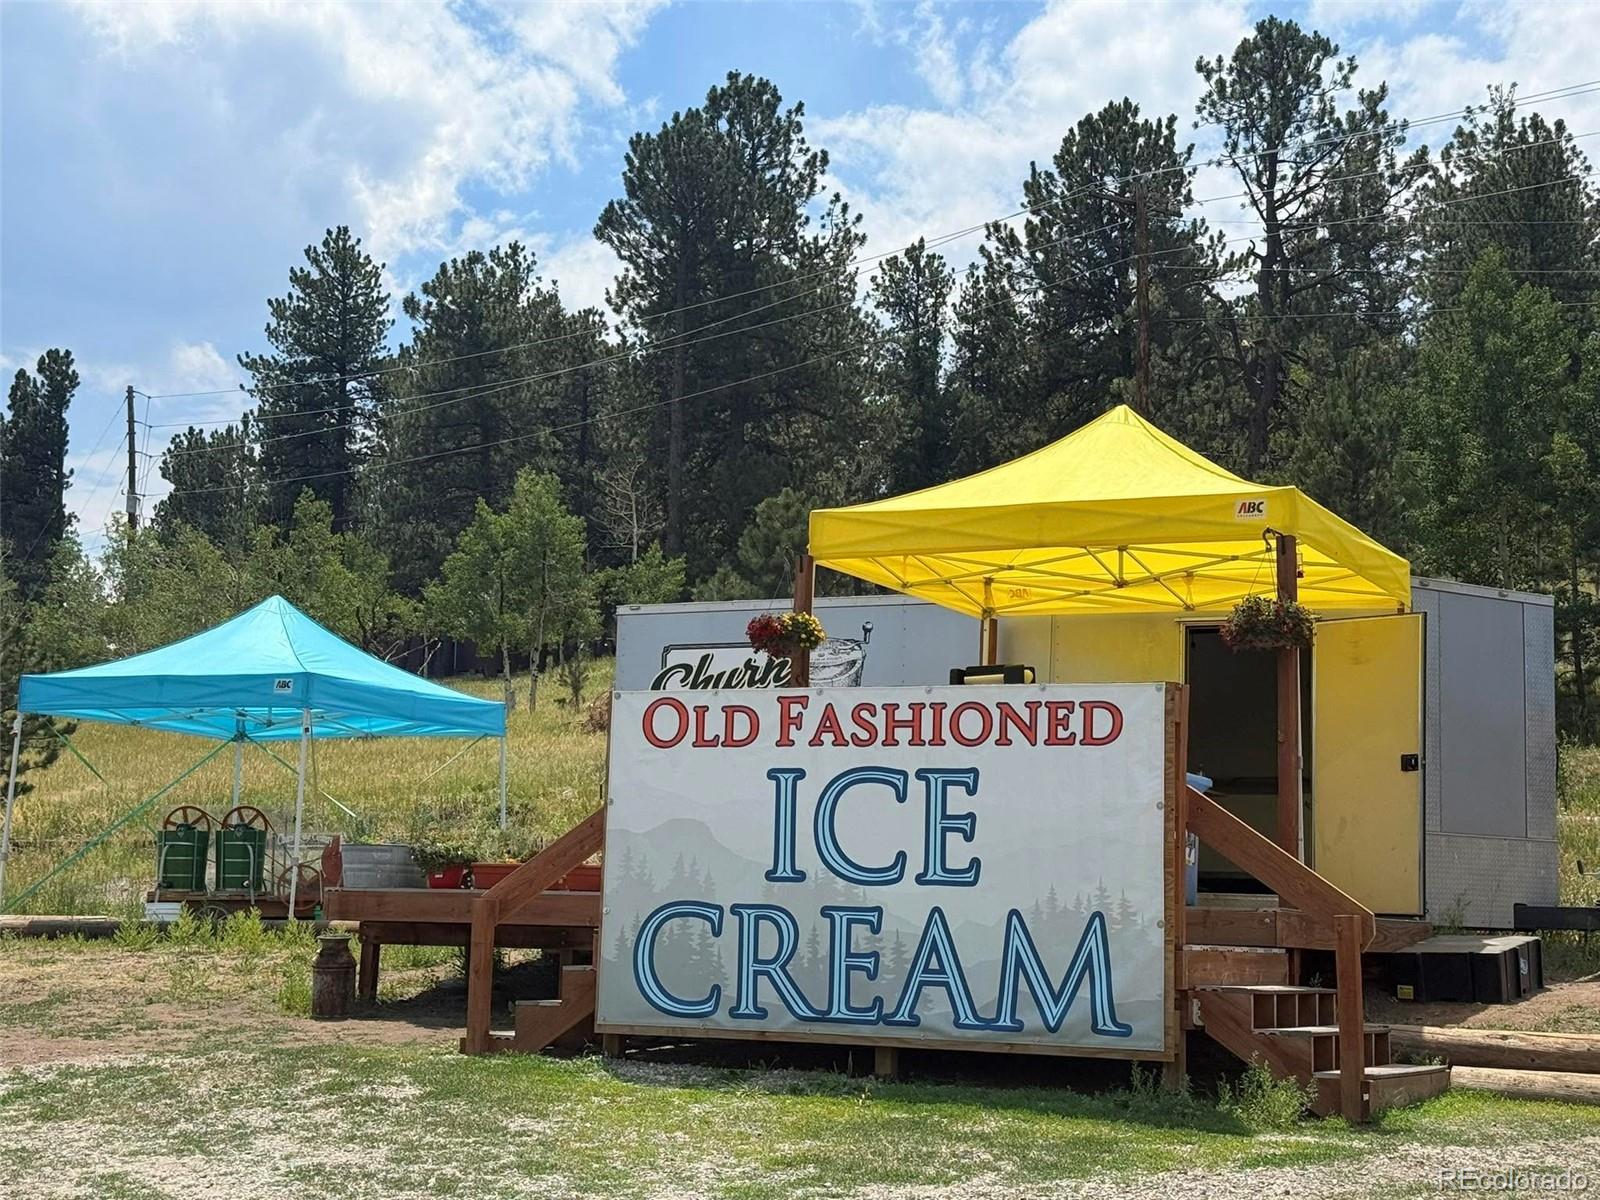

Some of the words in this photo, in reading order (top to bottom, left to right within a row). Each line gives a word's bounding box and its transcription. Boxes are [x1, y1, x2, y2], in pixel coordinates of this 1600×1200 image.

[1237, 501, 1264, 514] ABC
[275, 680, 292, 689] ABC
[650, 652, 792, 690] Churn
[642, 696, 760, 749] OLD
[775, 694, 1124, 748] FASHIONED
[766, 766, 982, 887] ICE
[633, 900, 1133, 1038] CREAM
